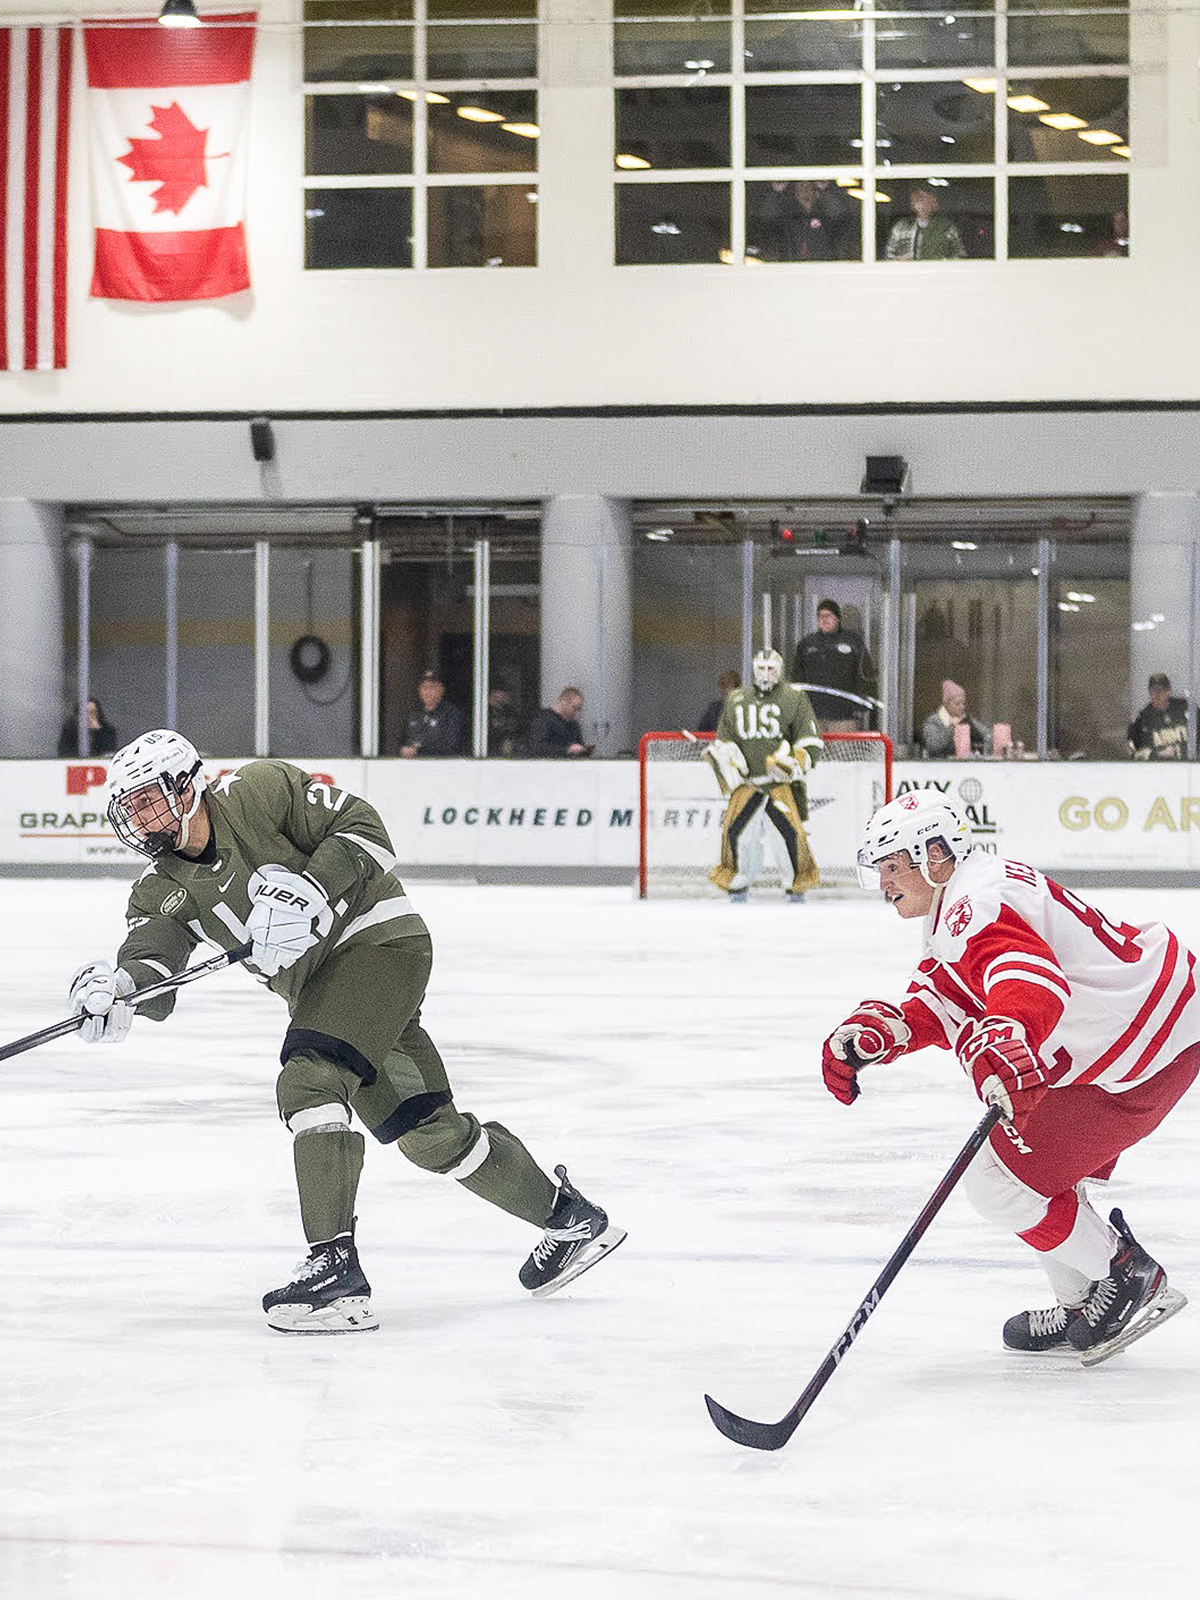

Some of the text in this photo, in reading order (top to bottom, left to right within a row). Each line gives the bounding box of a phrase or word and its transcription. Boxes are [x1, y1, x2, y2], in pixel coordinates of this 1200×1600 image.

[735, 703, 784, 740] U.S.
[423, 806, 593, 827] LOCKHEED
[609, 807, 730, 828] MRTI
[917, 822, 940, 836] CCM
[1058, 795, 1130, 832] GO
[998, 1120, 1034, 1155] CM
[831, 1287, 880, 1365] CCM
